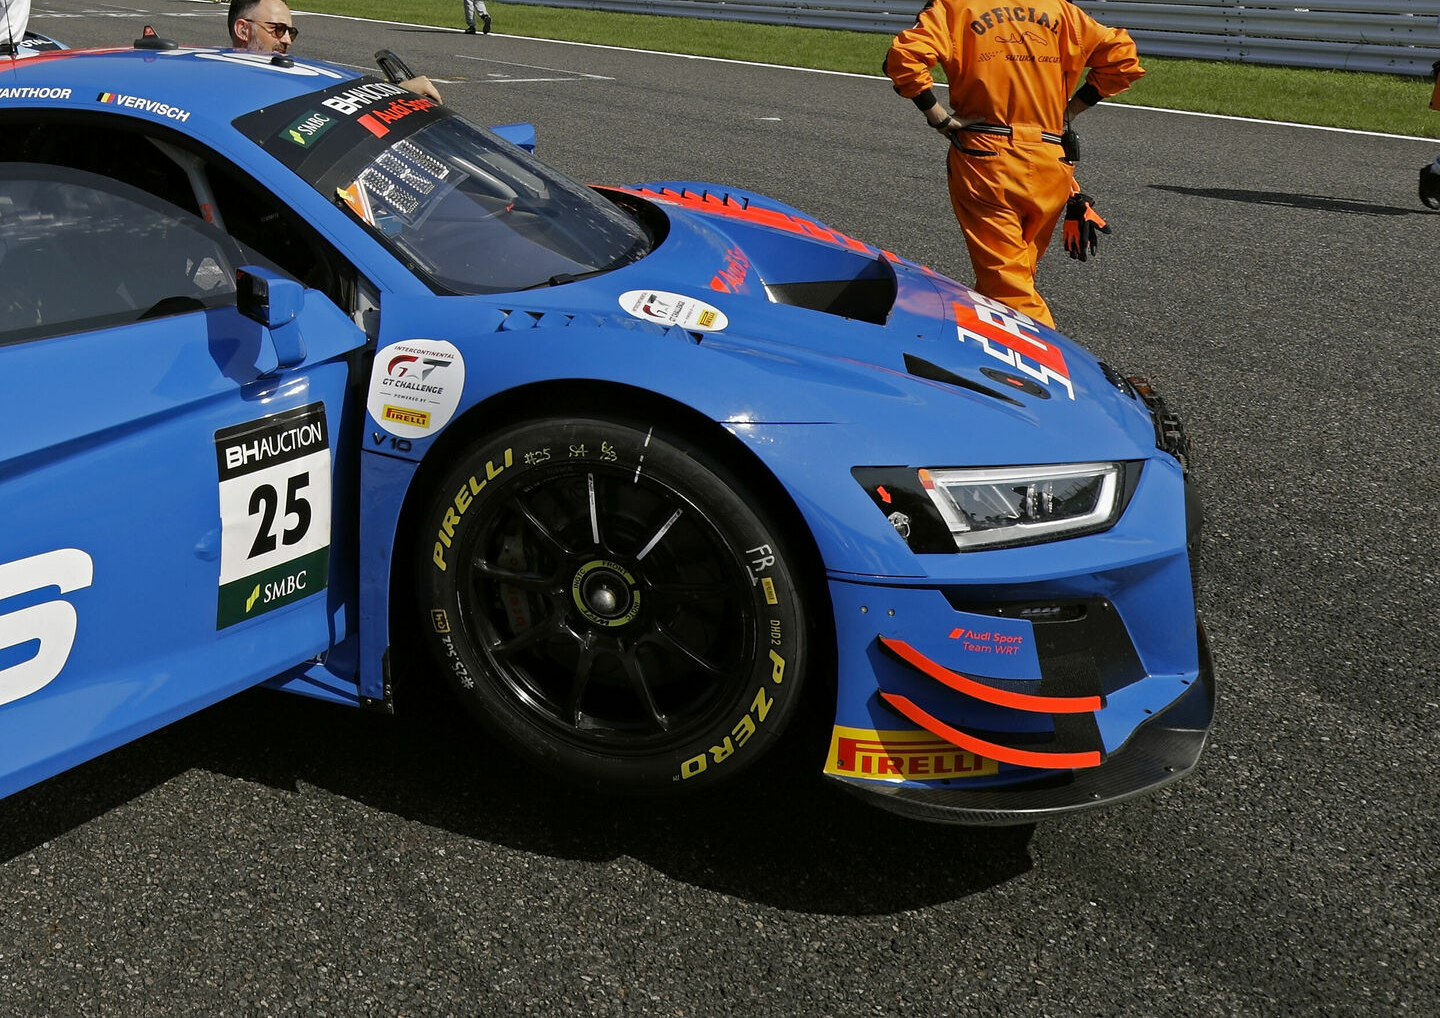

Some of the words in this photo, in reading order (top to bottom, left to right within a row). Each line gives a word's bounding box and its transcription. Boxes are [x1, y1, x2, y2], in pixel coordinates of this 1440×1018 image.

[970, 7, 1059, 35] OFFICIAL
[19, 39, 54, 49] OTAL
[1005, 54, 1036, 63] SUZUKA
[116, 94, 191, 123] VERVISCH
[375, 102, 409, 124] Audi
[296, 113, 331, 137] SMBC
[394, 345, 456, 360] INTERCONTINENTAL
[382, 378, 395, 386] GT
[394, 380, 444, 395] CHALLENGE
[385, 407, 427, 425] PIRELLI
[524, 448, 551, 465] #25
[246, 471, 312, 560] 25
[432, 447, 514, 572] PIRELLI
[602, 561, 626, 575] FRONT
[745, 544, 776, 572] FR
[263, 570, 308, 604] SMBC
[770, 619, 782, 646] DHD2
[964, 630, 991, 642] Audi
[992, 633, 1023, 644] Sport
[962, 641, 992, 653] Team
[994, 645, 1020, 655] WRT
[768, 648, 787, 684] P
[679, 686, 775, 780] ZERO
[837, 737, 984, 776] PIRELLI
